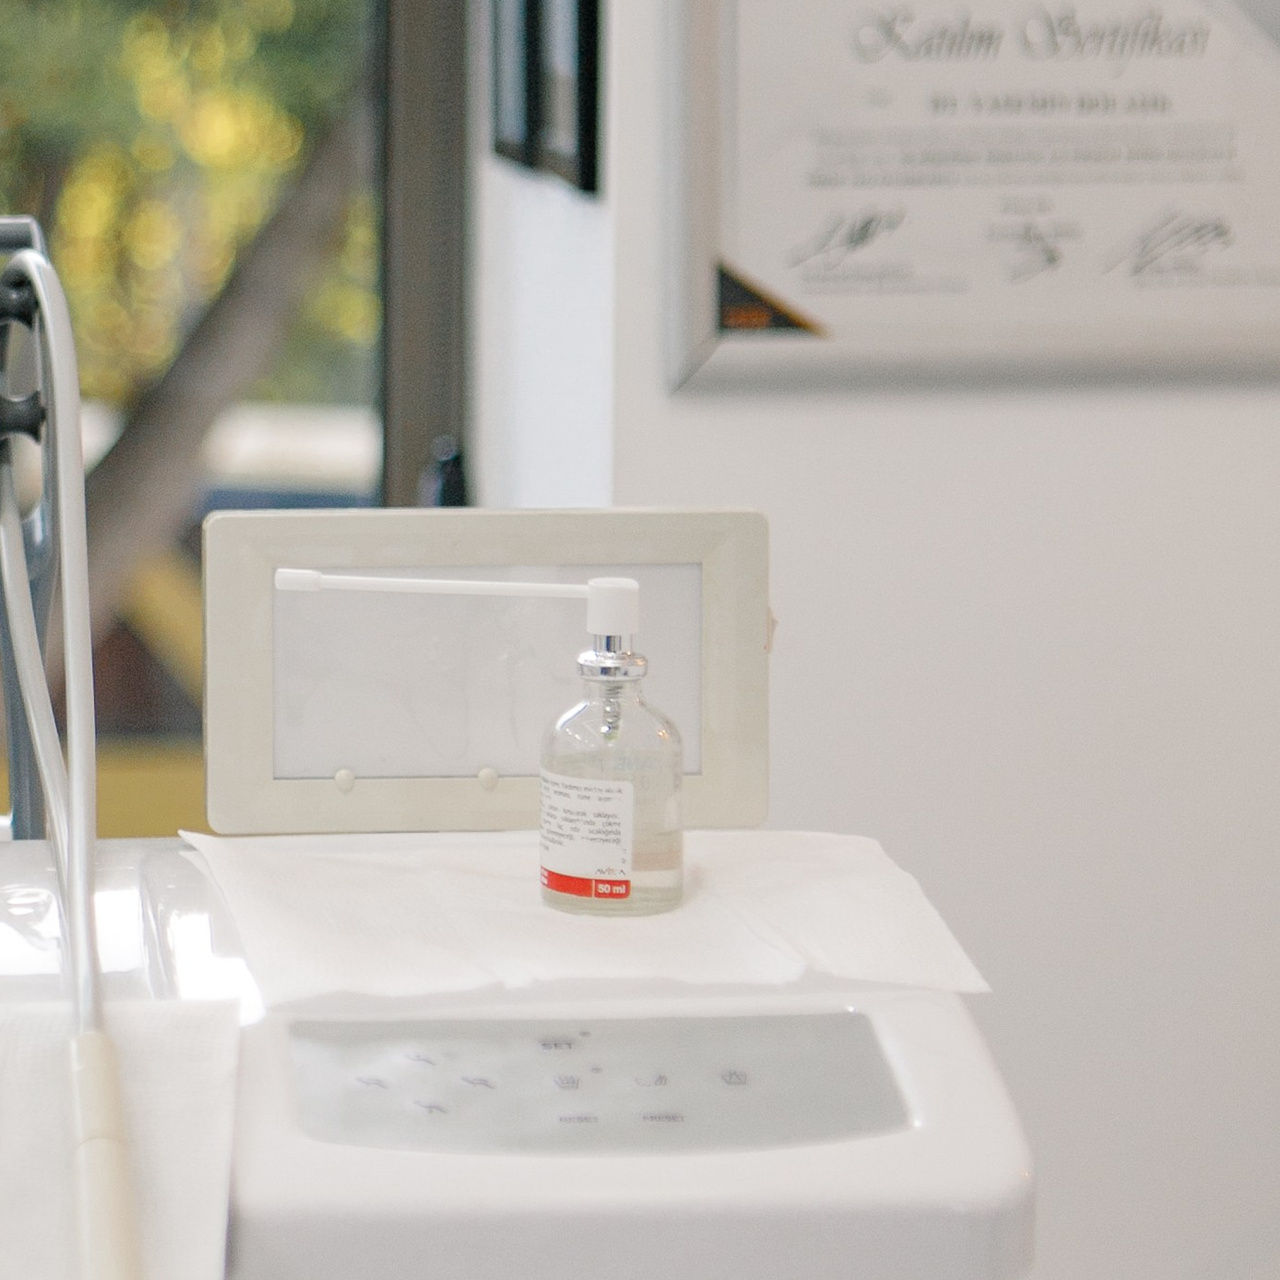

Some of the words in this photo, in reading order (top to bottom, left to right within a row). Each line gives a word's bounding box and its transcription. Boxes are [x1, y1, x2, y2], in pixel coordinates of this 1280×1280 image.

[597, 884, 611, 894] 50
[612, 884, 626, 894] ml
[541, 1041, 573, 1050] SET
